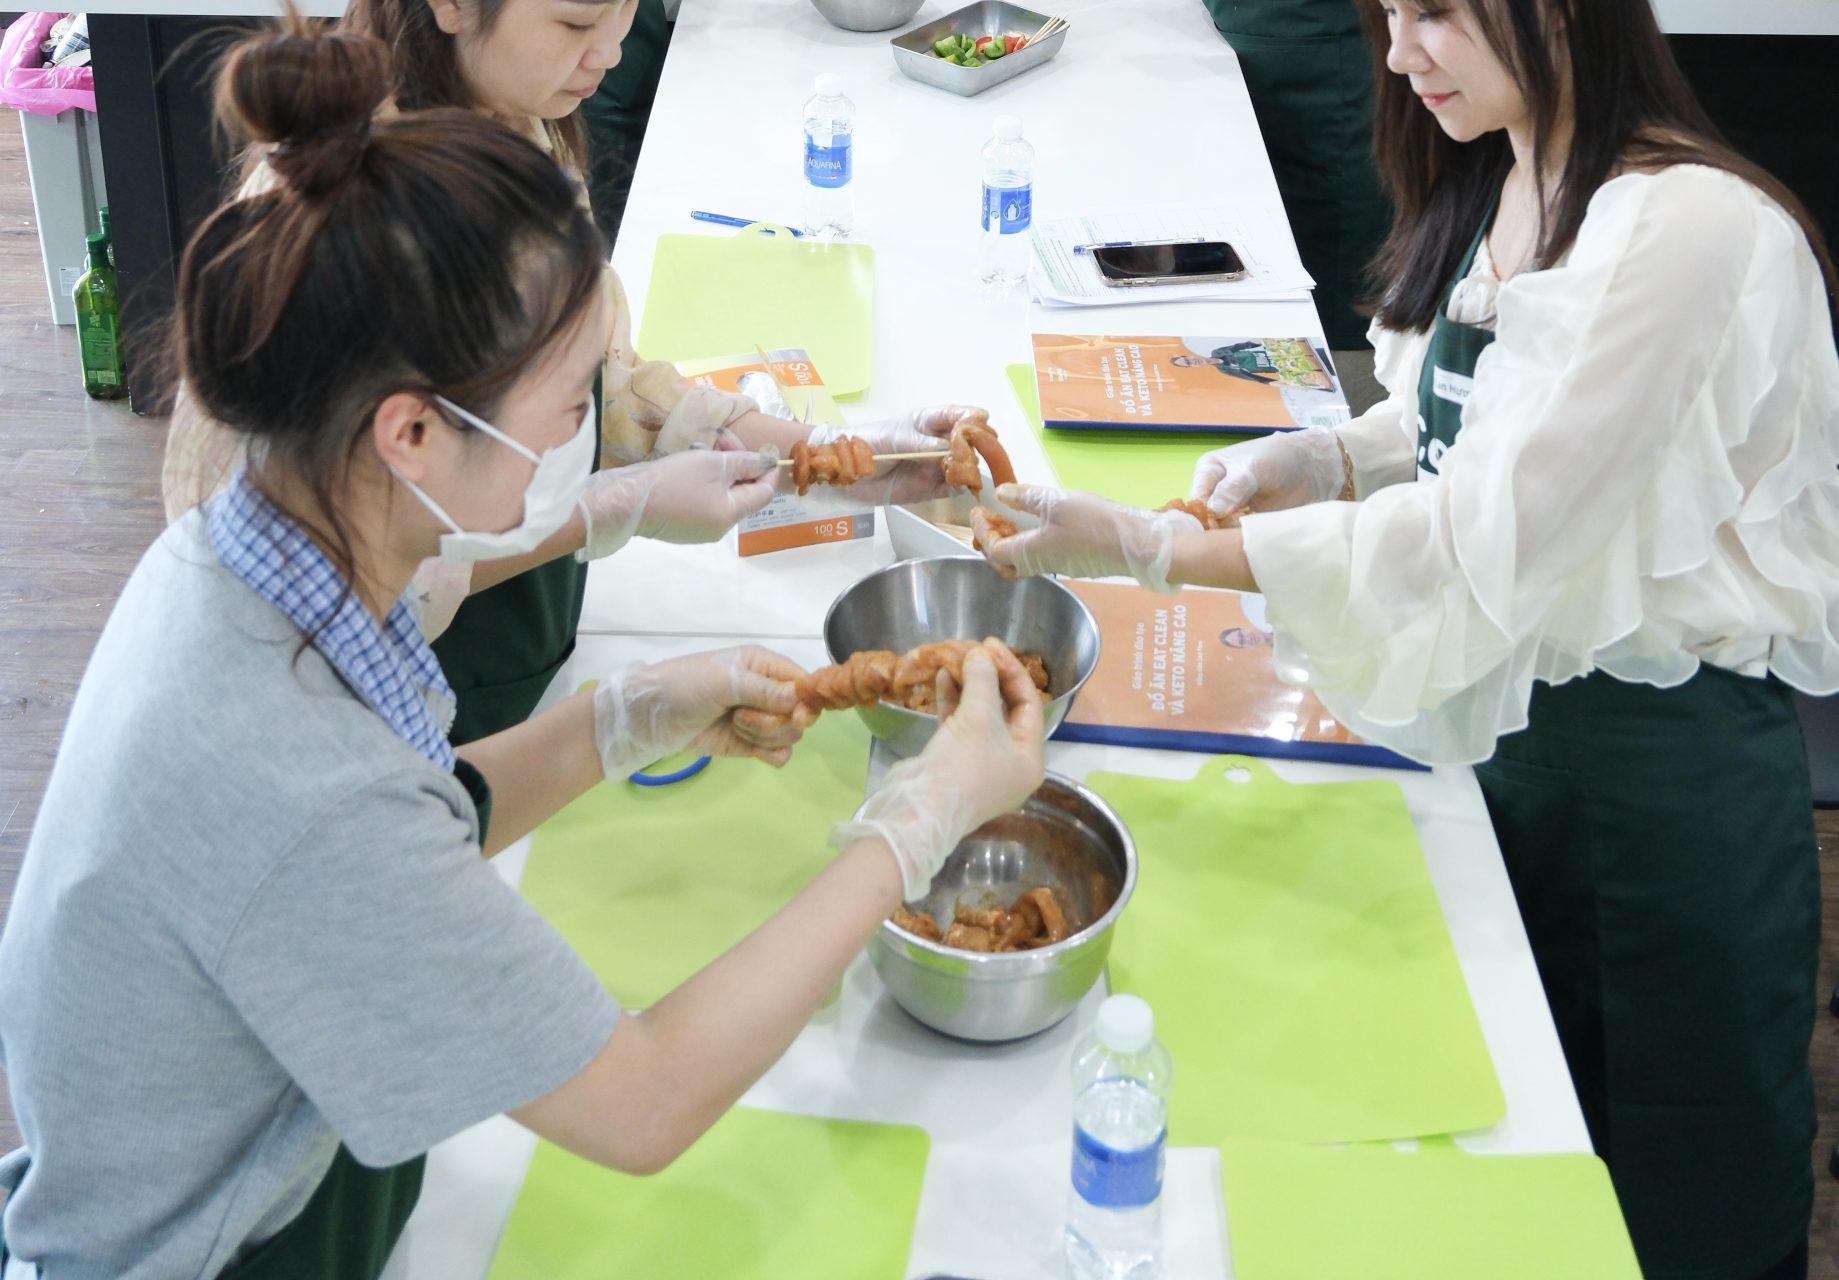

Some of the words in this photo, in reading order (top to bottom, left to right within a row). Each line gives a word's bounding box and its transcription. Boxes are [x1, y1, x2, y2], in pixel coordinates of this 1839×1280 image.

[807, 157, 842, 170] AQUAFINA
[1114, 347, 1129, 369] CLEAN
[1128, 345, 1142, 359] CAO
[1119, 370, 1132, 383] EAT
[1138, 379, 1151, 401] KETO
[1137, 404, 1153, 416] VÀ
[814, 523, 833, 535] 100
[836, 521, 849, 536] S
[1172, 604, 1187, 628] CAO
[1153, 609, 1168, 645] CLEAN
[1153, 648, 1167, 670] EAT
[1171, 666, 1186, 696] KETO
[1168, 699, 1185, 716] VÀ
